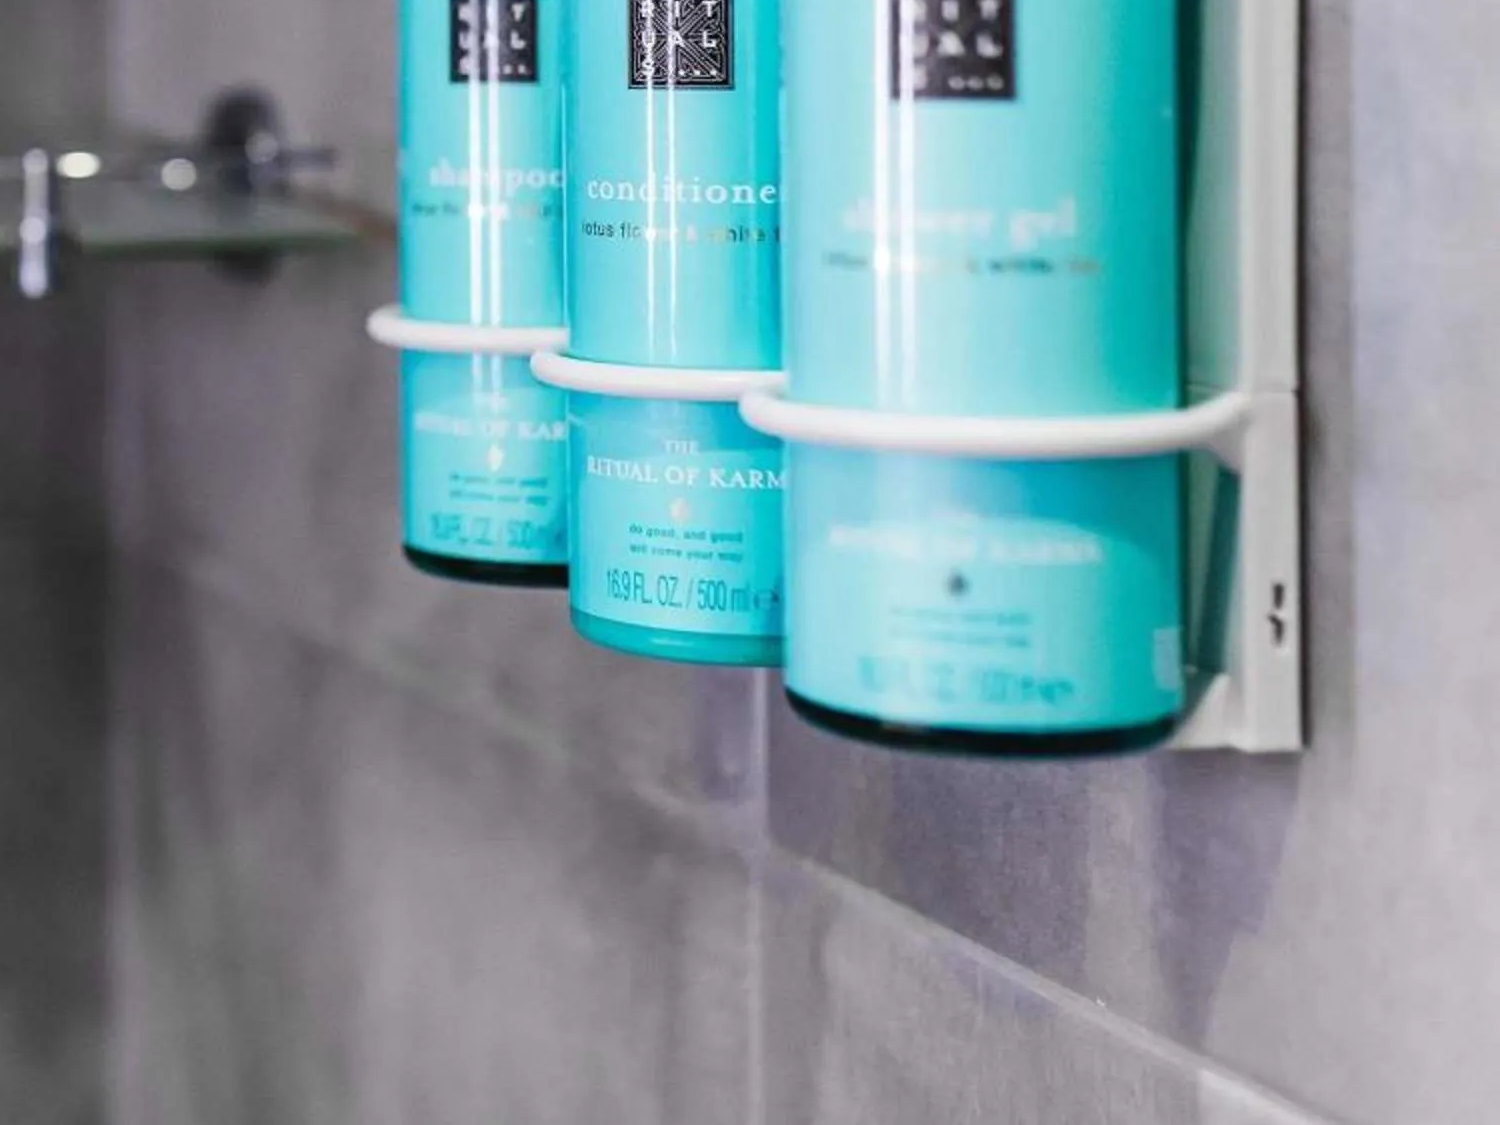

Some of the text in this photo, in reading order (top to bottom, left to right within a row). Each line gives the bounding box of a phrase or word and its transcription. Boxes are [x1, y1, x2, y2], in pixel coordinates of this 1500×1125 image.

[586, 175, 779, 205] conditione
[586, 455, 784, 490] RITUAL OF KARM
[697, 579, 728, 613] 500
